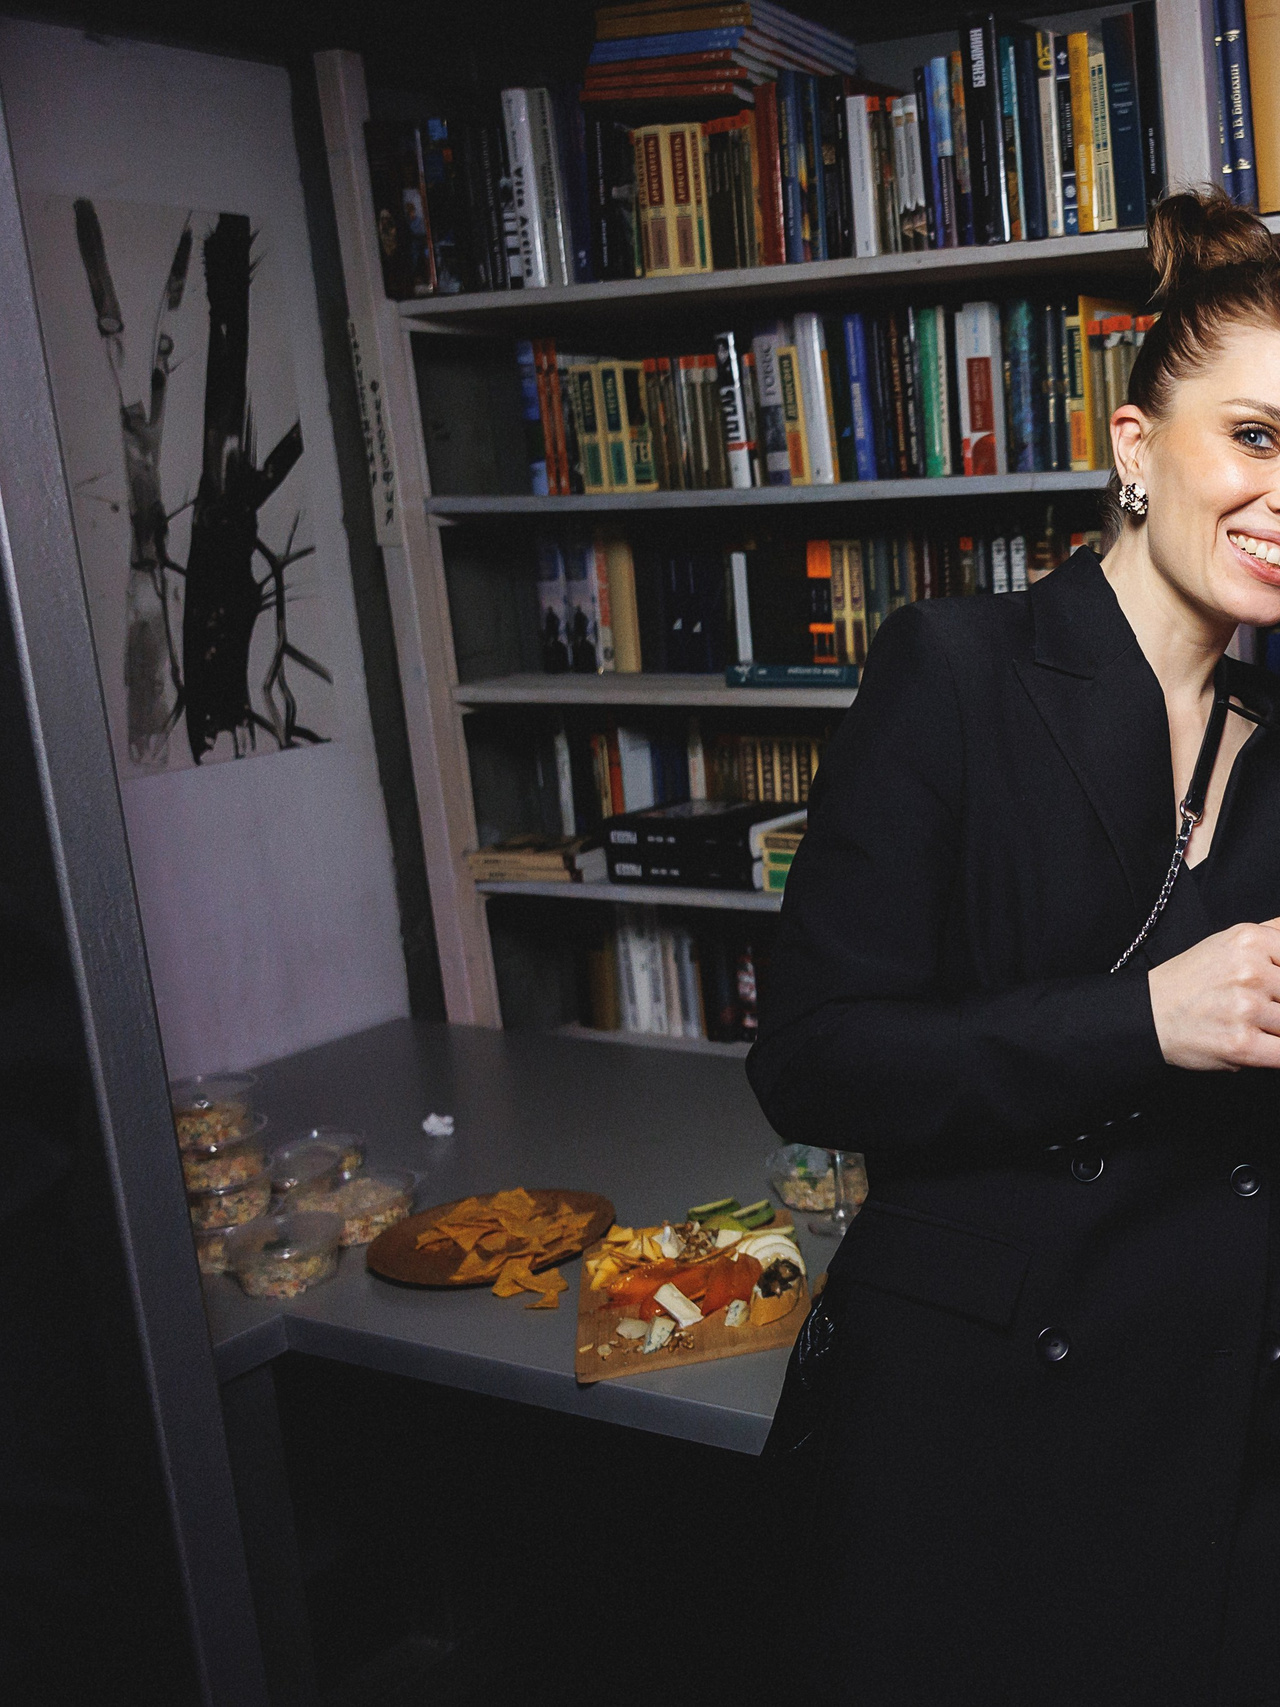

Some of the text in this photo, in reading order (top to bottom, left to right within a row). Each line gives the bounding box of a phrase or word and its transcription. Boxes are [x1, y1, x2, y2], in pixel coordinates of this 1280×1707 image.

[970, 28, 986, 88] БЕНЬЯМИН
[1230, 63, 1244, 139] В. В. Бибихин
